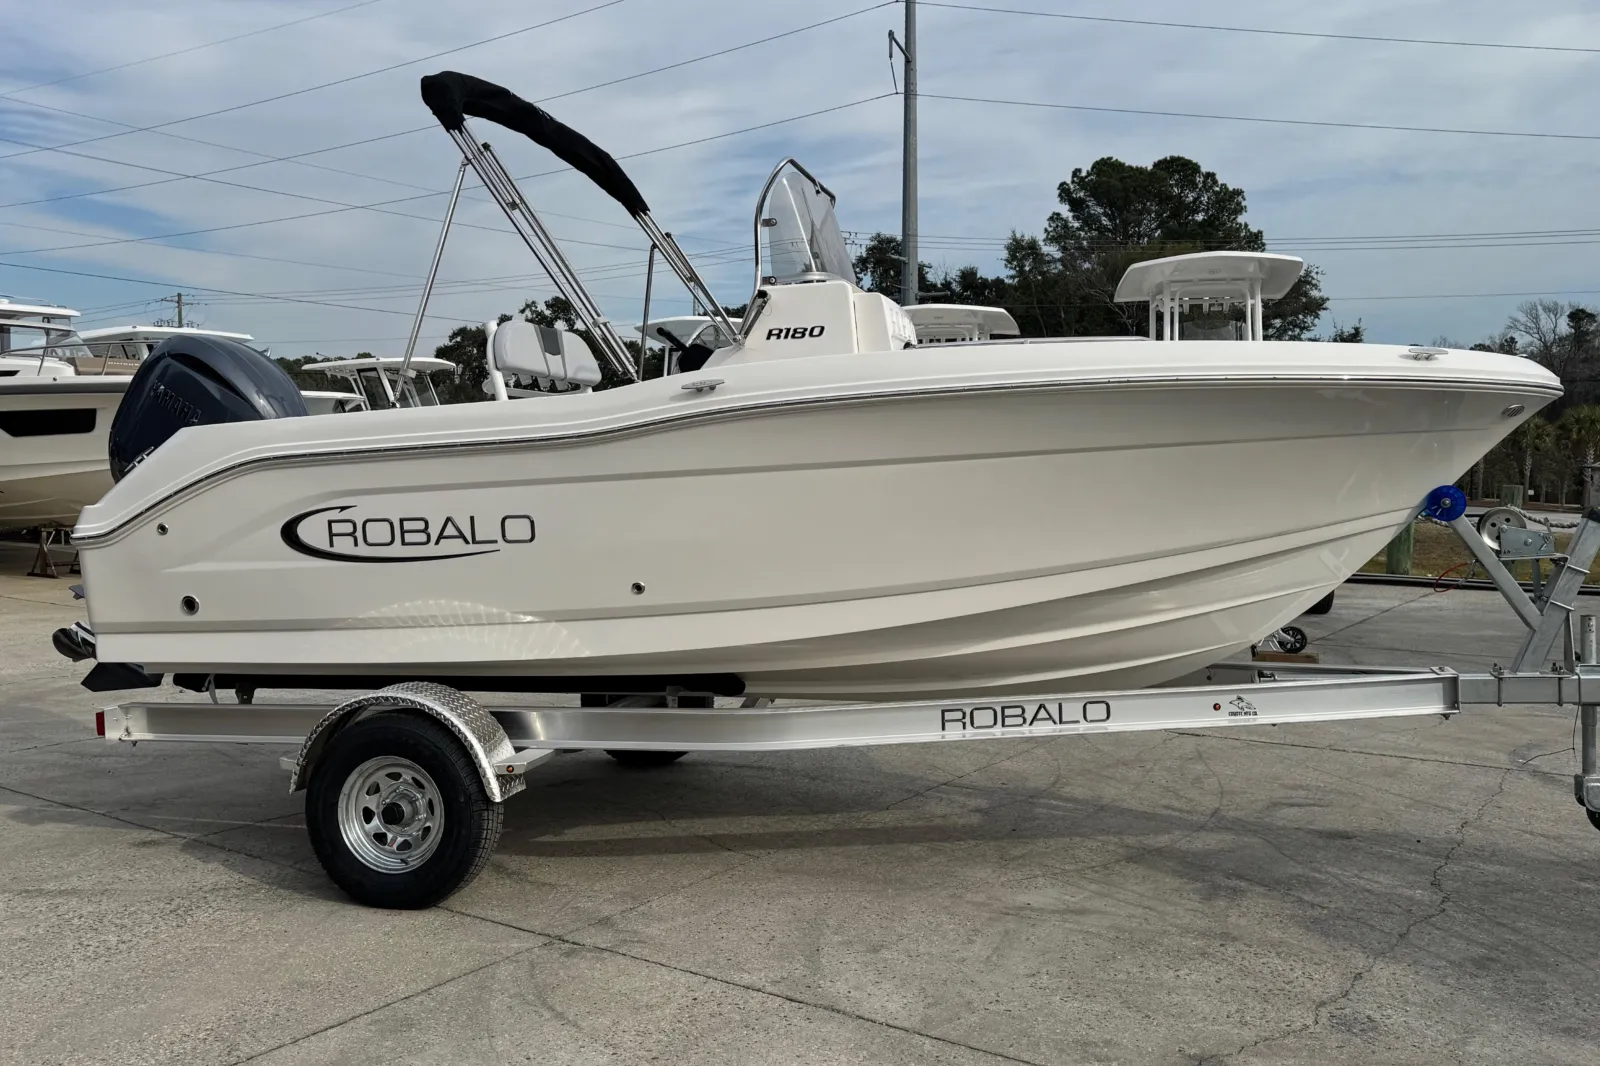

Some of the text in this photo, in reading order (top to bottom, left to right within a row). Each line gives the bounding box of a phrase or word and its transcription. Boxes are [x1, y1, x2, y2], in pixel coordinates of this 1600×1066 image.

[765, 325, 825, 341] R180
[149, 379, 202, 425] YAMAHA
[327, 514, 536, 548] ROBALO
[941, 700, 1111, 731] ROBALO
